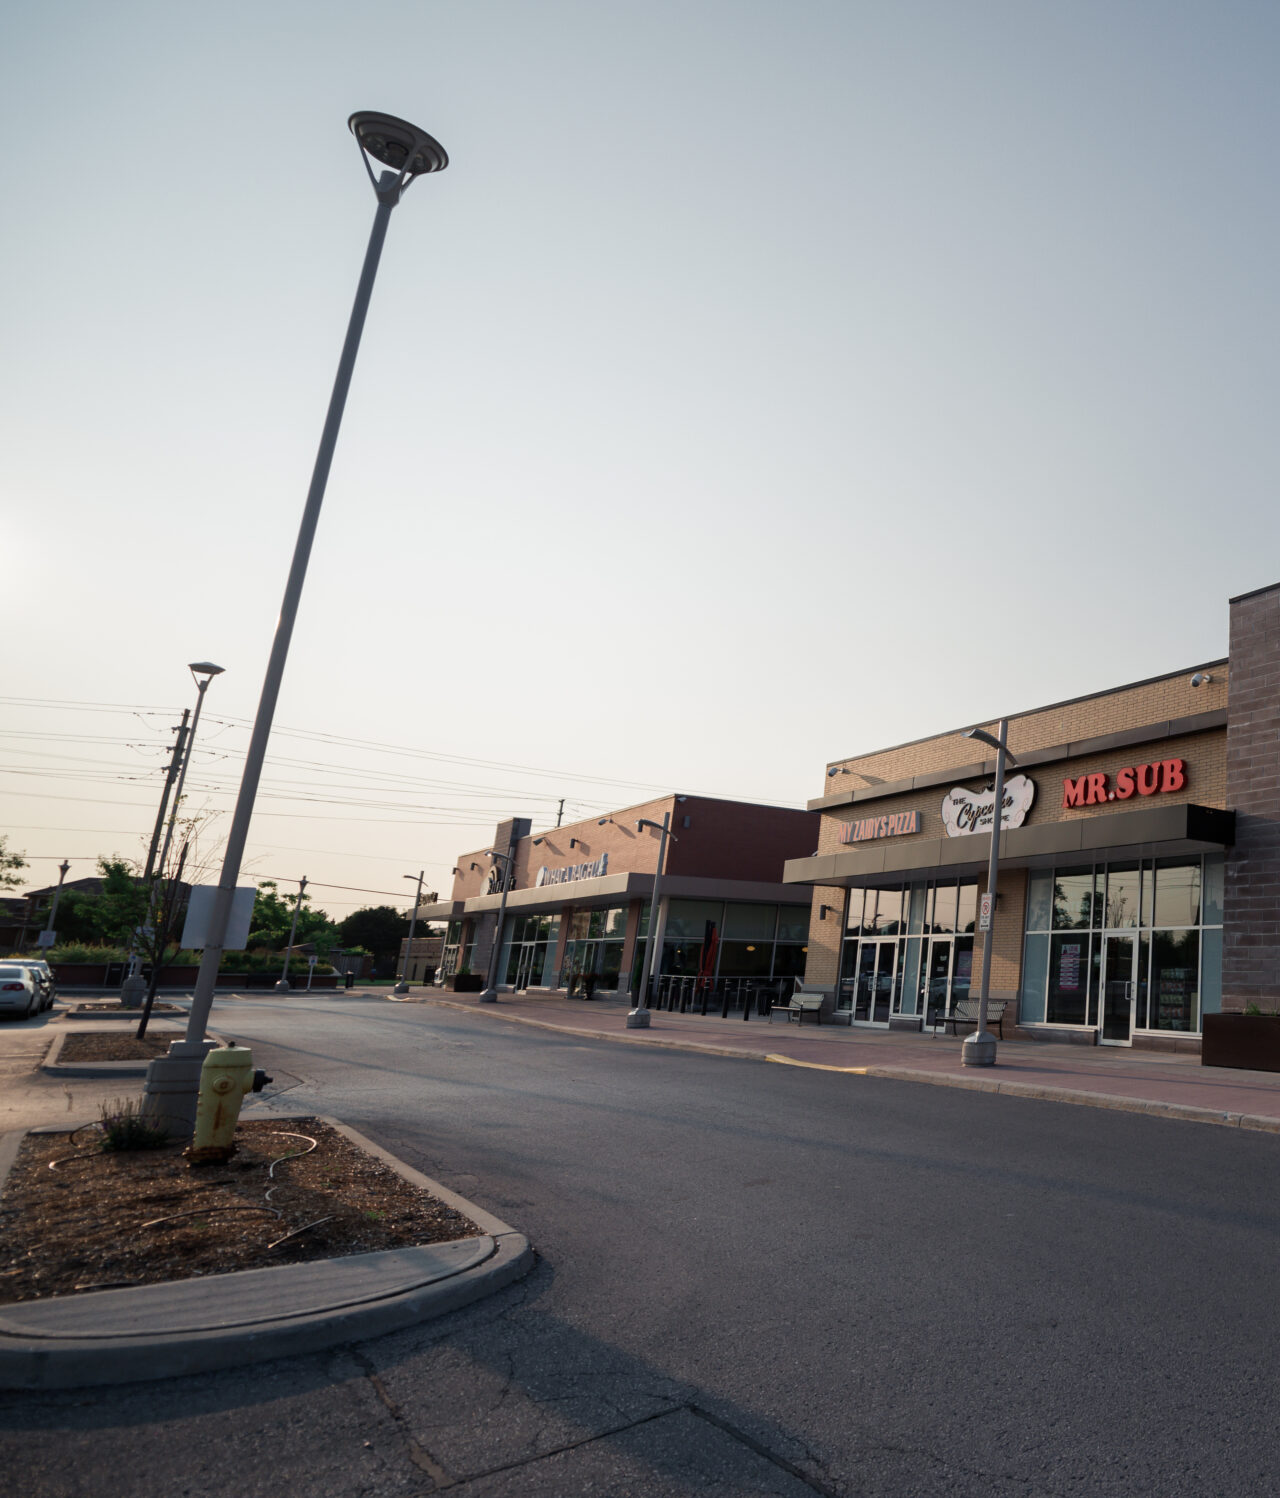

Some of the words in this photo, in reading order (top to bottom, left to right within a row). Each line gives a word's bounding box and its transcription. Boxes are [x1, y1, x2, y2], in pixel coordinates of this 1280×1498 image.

[952, 797, 967, 806] THE
[840, 822, 853, 843] MY
[887, 810, 918, 836] PIZZA
